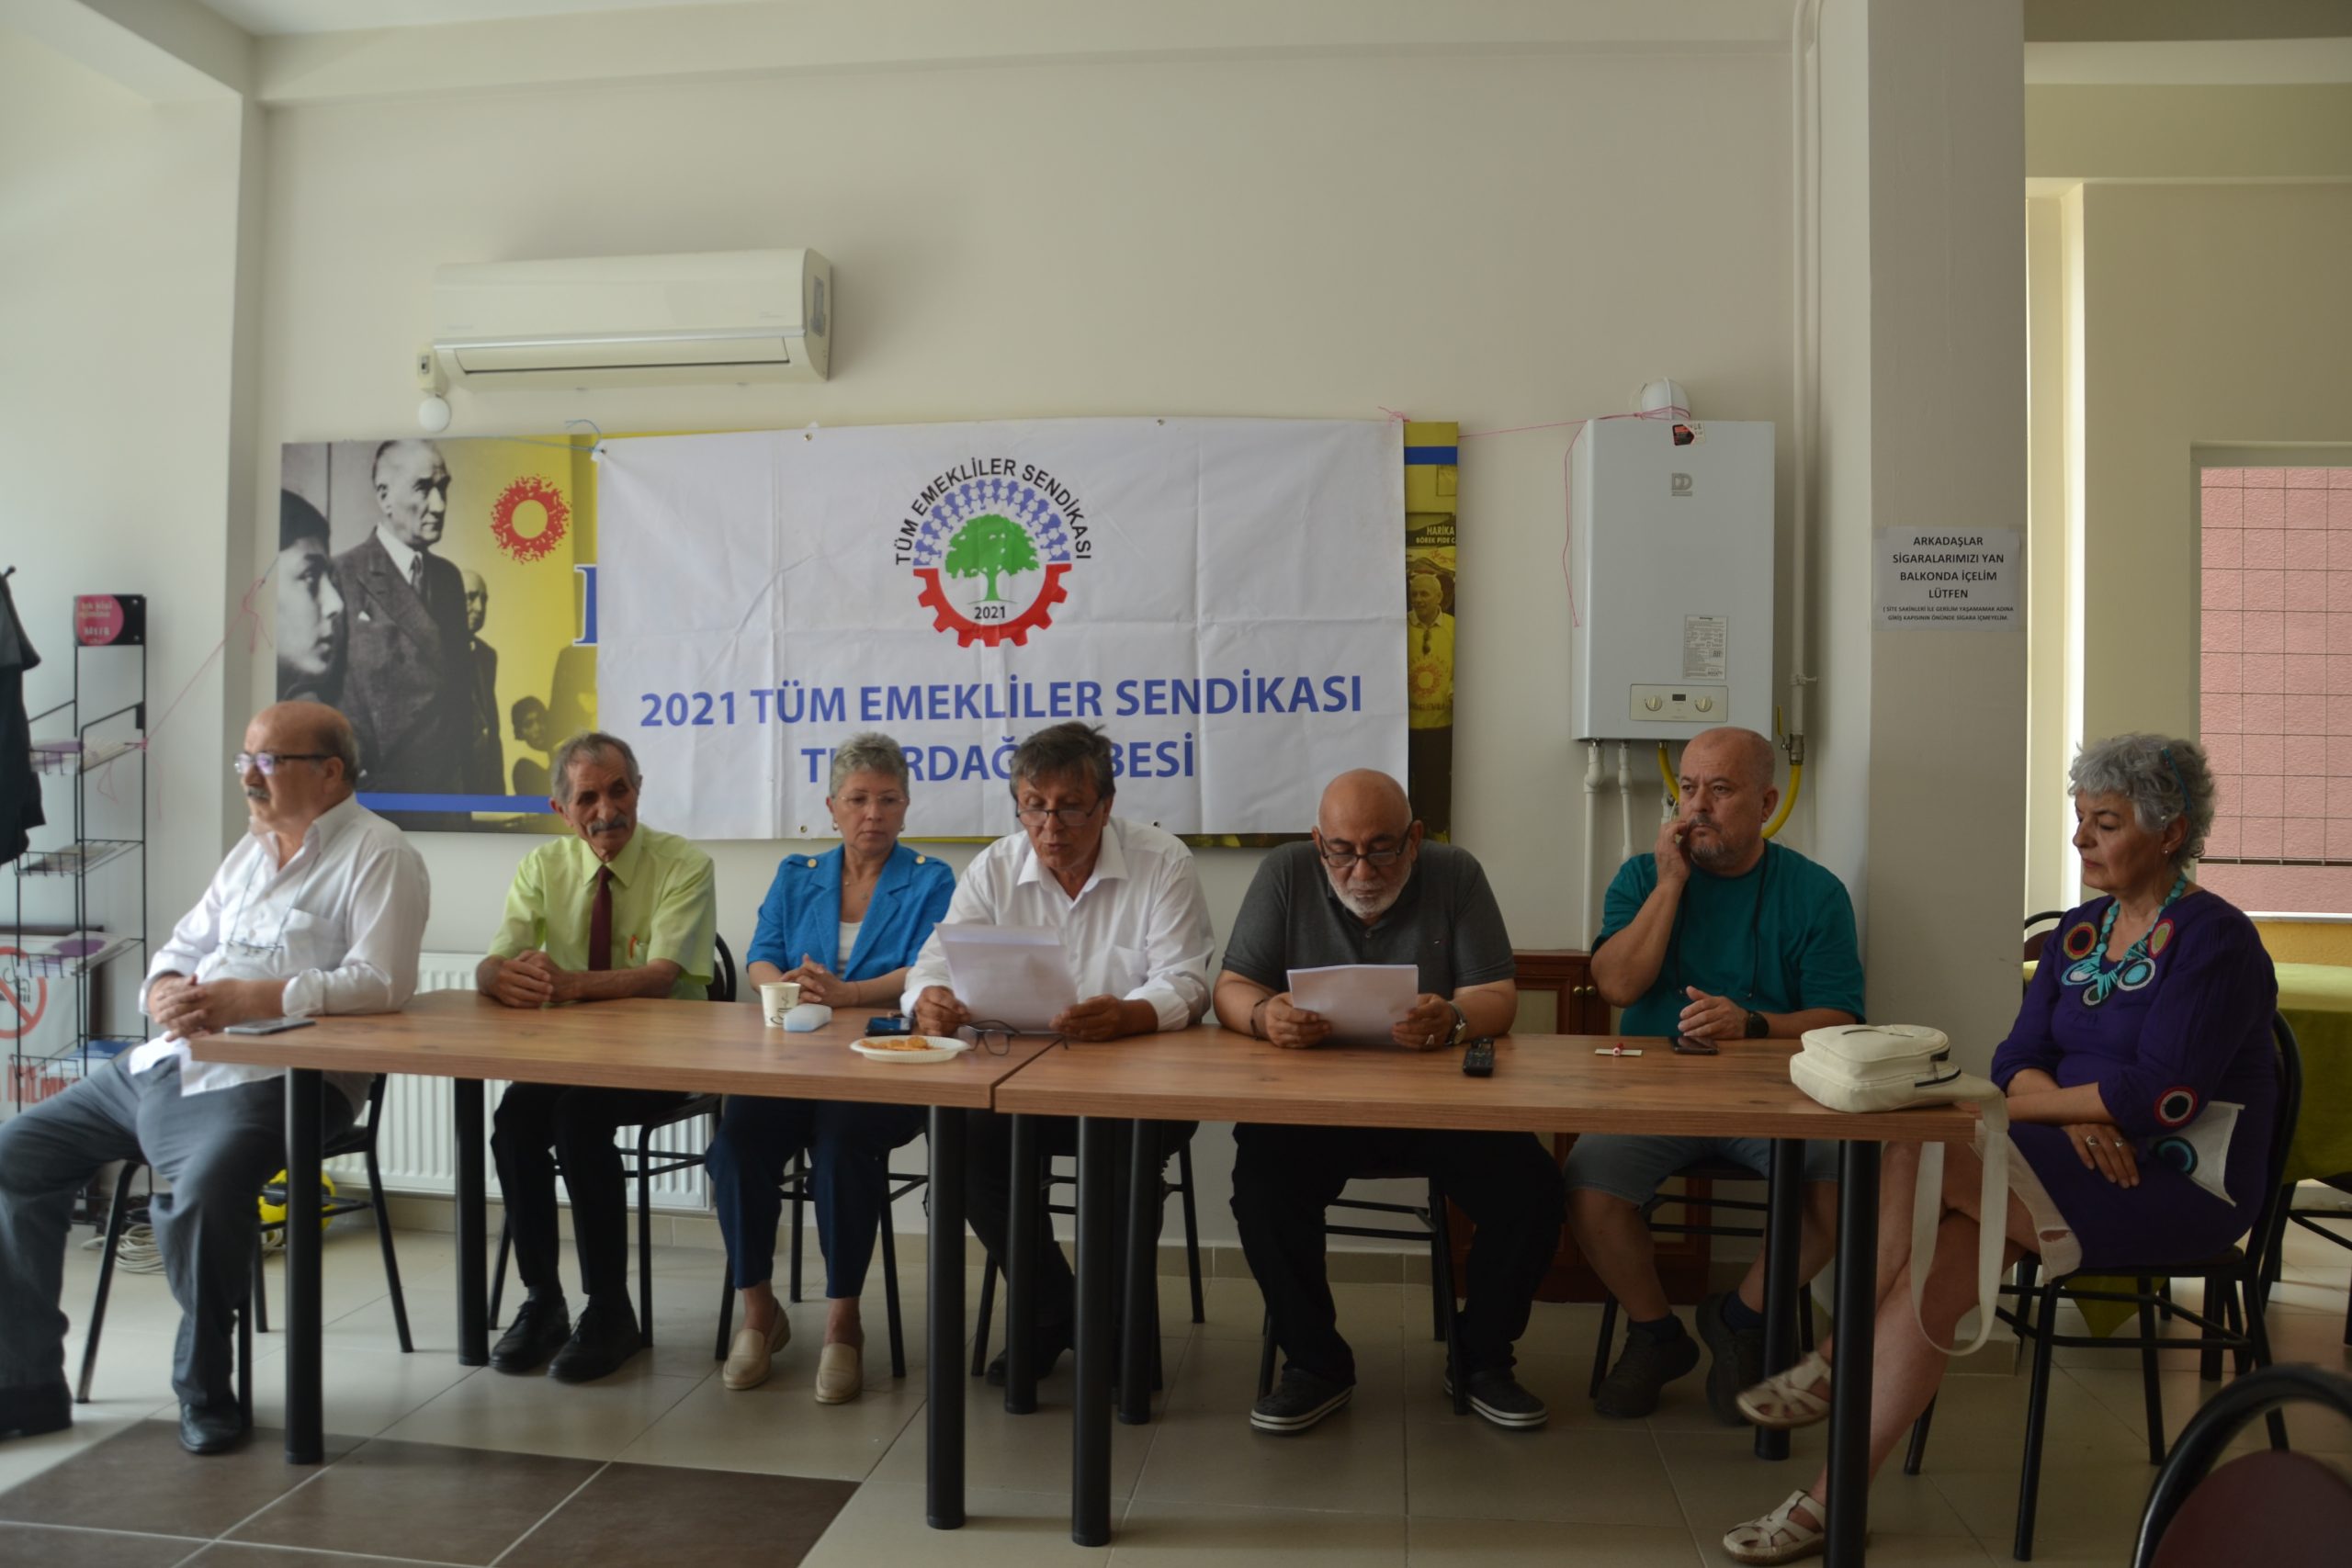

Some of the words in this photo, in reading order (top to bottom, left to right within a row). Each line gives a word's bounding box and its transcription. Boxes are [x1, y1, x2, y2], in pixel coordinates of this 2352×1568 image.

[893, 518, 919, 566] TÜM
[910, 457, 1017, 517] EMEKLİLER
[1022, 463, 1092, 560] SENDİKASI
[1913, 536, 1984, 547] ARKADAŞLAR
[1893, 552, 1979, 564] SİGARALARIMIZI
[1982, 554, 2005, 564] YAN
[1900, 571, 1959, 581] BALKONDA
[1962, 570, 1997, 582] İÇELİM
[1928, 588, 1969, 599] LÜTFEN
[974, 605, 1007, 620] 2021
[640, 691, 735, 728] 2021
[750, 680, 847, 724] TÜM
[860, 673, 1103, 722] EMEKLİLER
[1114, 668, 1362, 717] SENDİKASI
[800, 736, 1019, 783] TRDAĞ
[1109, 731, 1193, 778] BESİ
